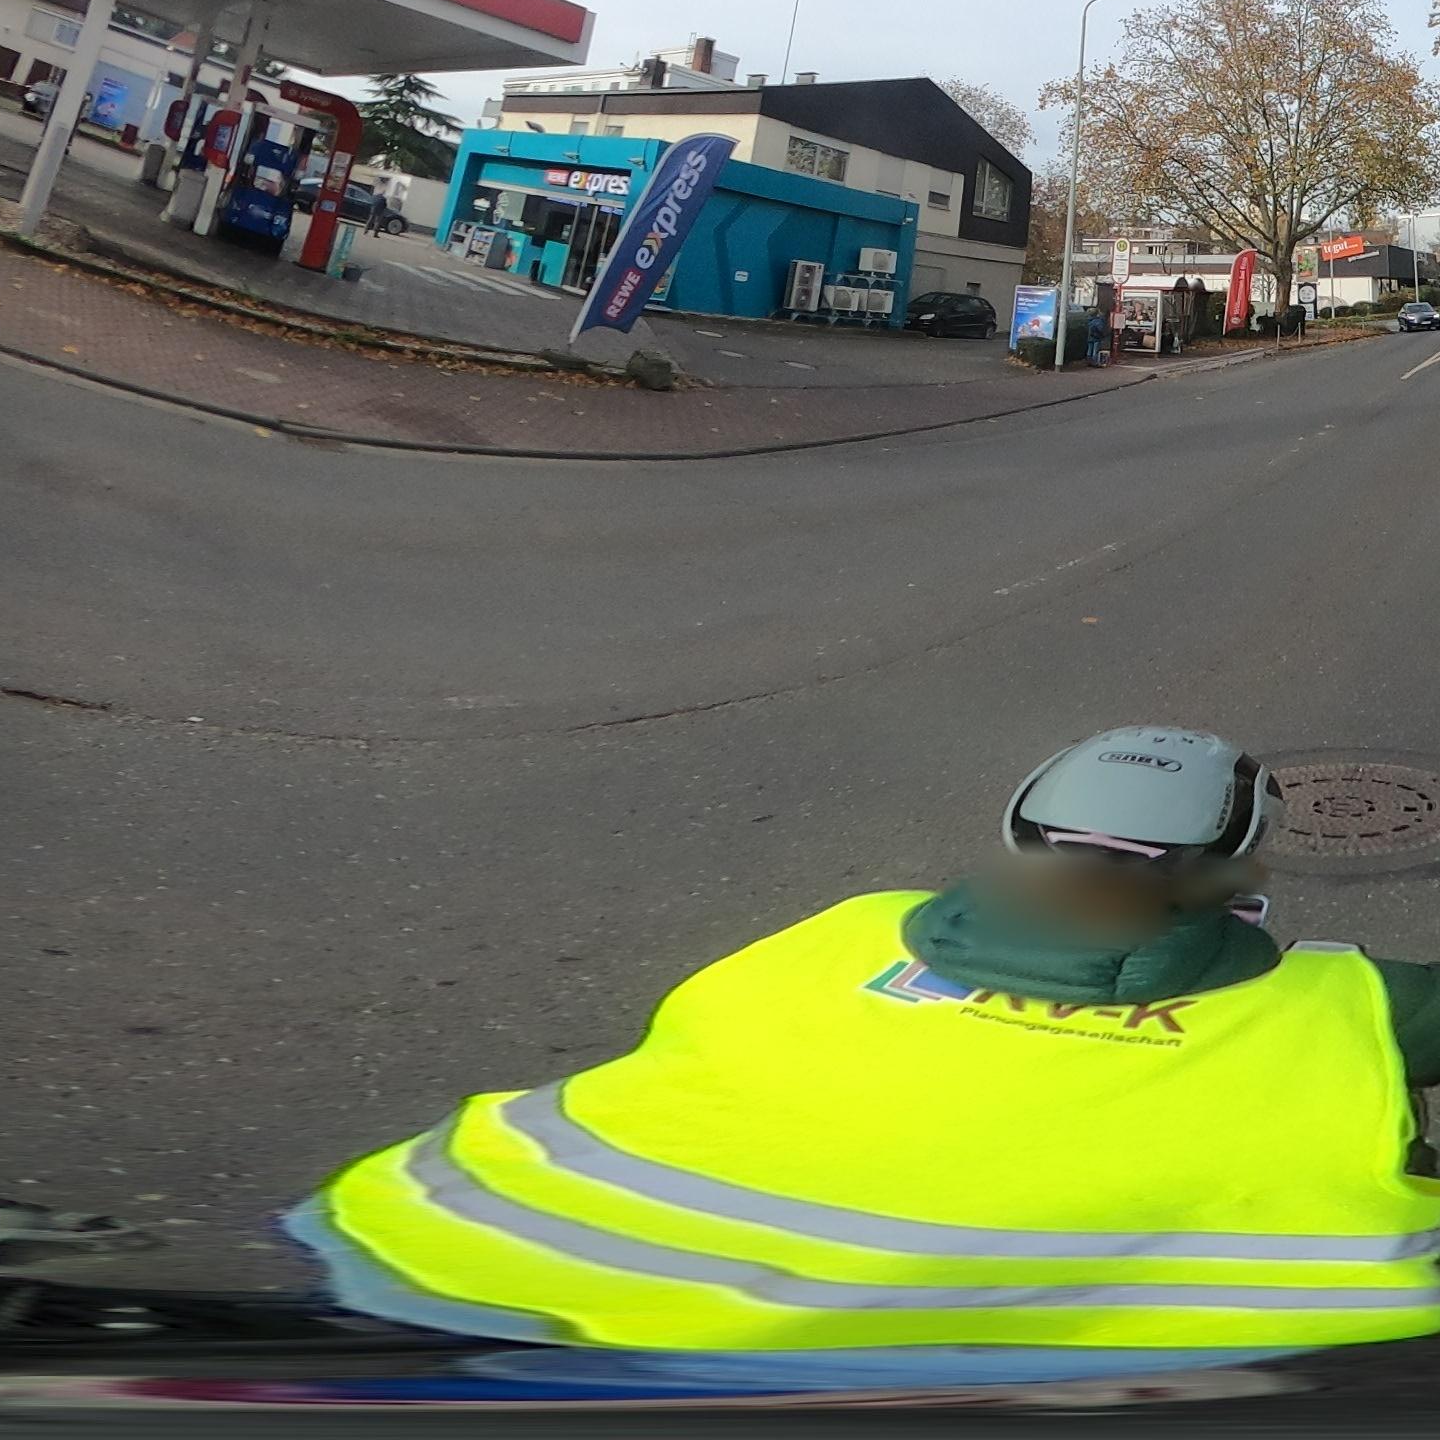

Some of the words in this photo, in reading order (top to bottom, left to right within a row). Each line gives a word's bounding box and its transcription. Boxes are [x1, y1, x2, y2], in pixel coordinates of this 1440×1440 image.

[606, 271, 641, 318] REWE
[635, 150, 708, 270] express
[959, 1006, 1183, 1048] Planungsgesellschaft
